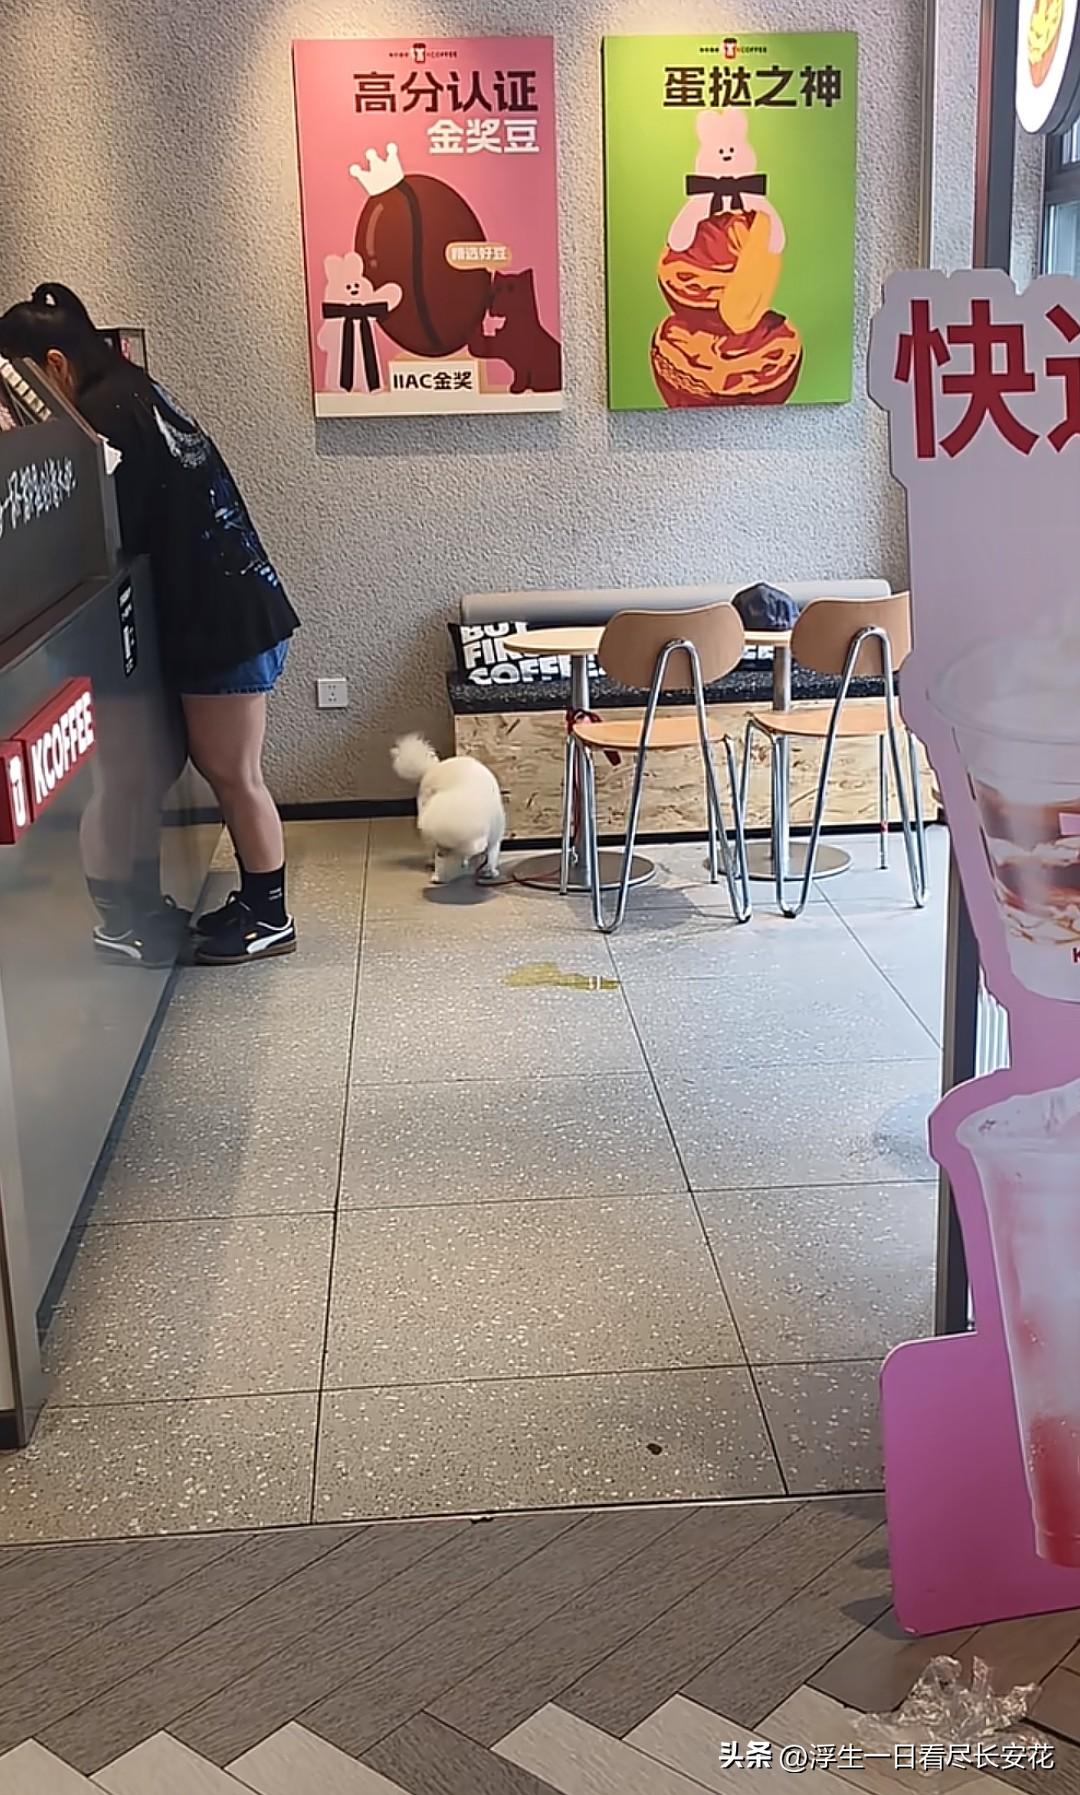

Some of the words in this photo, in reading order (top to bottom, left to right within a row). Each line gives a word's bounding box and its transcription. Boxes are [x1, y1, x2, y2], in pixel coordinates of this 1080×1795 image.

[353, 70, 539, 113] 高分认证
[663, 65, 842, 108] 蛋挞之神
[427, 118, 540, 154] 金奖豆
[393, 371, 473, 391] IIAC金奖
[31, 691, 95, 805] KCOFFEE
